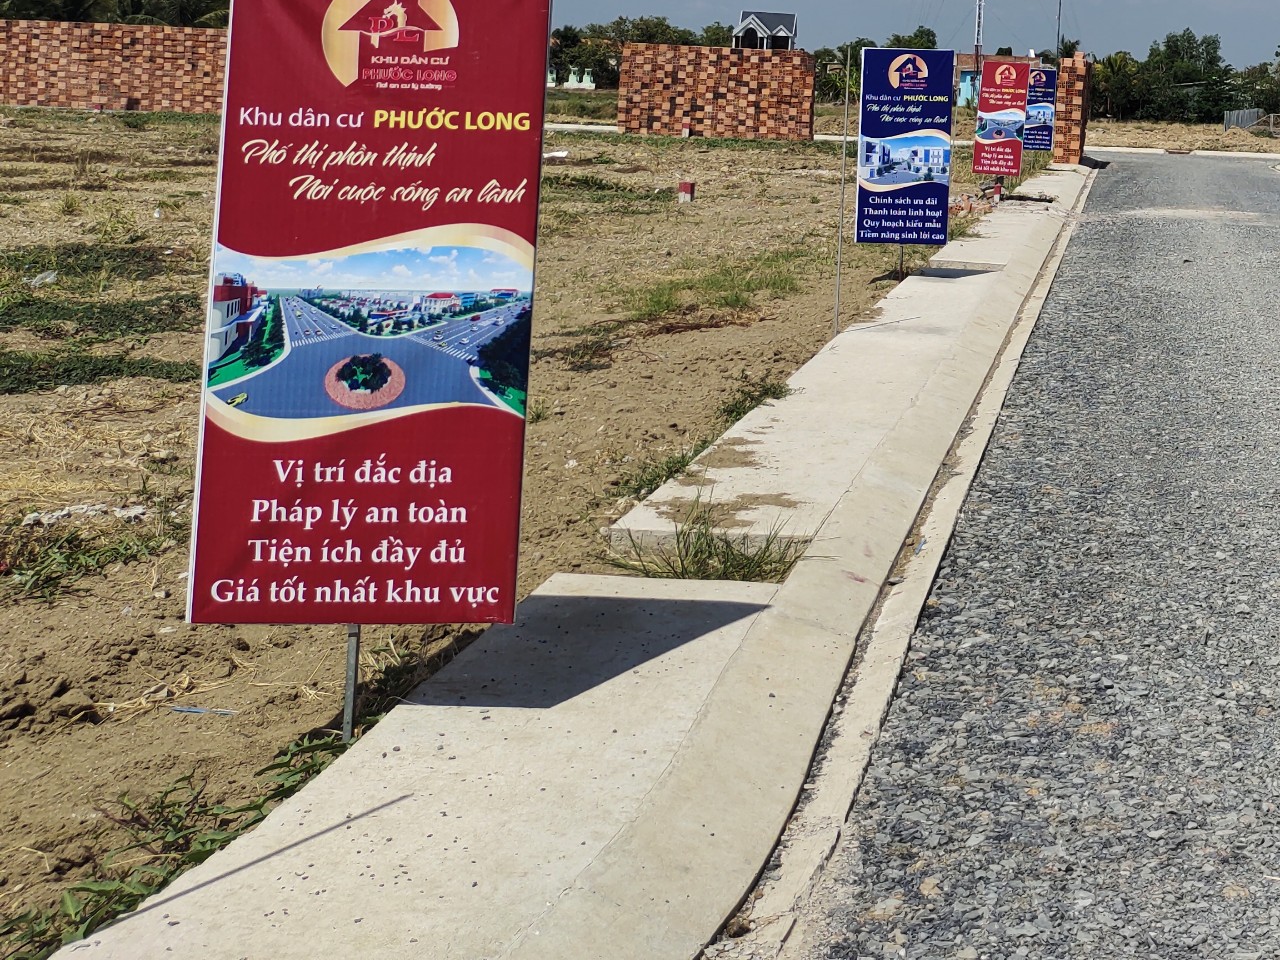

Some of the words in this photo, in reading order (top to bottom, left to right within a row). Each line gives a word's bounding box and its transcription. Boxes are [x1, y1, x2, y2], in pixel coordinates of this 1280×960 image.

[371, 56, 398, 64] KHU
[401, 55, 428, 64] DÂN
[430, 56, 450, 65] CƯ
[362, 66, 413, 80] PHƯỚC
[417, 70, 457, 81] LONG
[239, 107, 282, 126] Khu
[288, 108, 330, 127] dân
[336, 111, 364, 128] cư
[374, 107, 459, 130] PHƯỚC
[464, 112, 530, 131] LONG
[241, 138, 293, 165] Phố
[293, 140, 326, 169] thị
[323, 141, 378, 171] phồn
[382, 142, 438, 171] thịnh
[289, 174, 339, 201] Nơi
[338, 182, 386, 204] cuộc
[390, 178, 441, 211] sống
[445, 185, 473, 203] an
[477, 178, 528, 204] lành
[869, 196, 892, 204] Chính
[863, 207, 888, 216] Thanh
[925, 210, 942, 218] hoạt
[863, 219, 880, 228] Quy
[882, 219, 904, 228] hoạch
[859, 229, 878, 238] Tiềm
[273, 459, 305, 488] Vị
[314, 459, 346, 483] trí
[354, 453, 401, 484] đắc
[409, 460, 453, 488] địa
[251, 499, 322, 530] Pháp
[330, 499, 358, 530] lý
[365, 505, 399, 523] an
[408, 499, 468, 523] toàn
[248, 538, 311, 567] Tiện
[320, 539, 362, 563] ích
[371, 536, 422, 570] đầy
[430, 539, 466, 563] đủ
[211, 578, 260, 603] Giá
[269, 576, 306, 603] tốt
[314, 576, 378, 603] nhất
[385, 579, 440, 603] khu
[449, 584, 499, 608] vực
